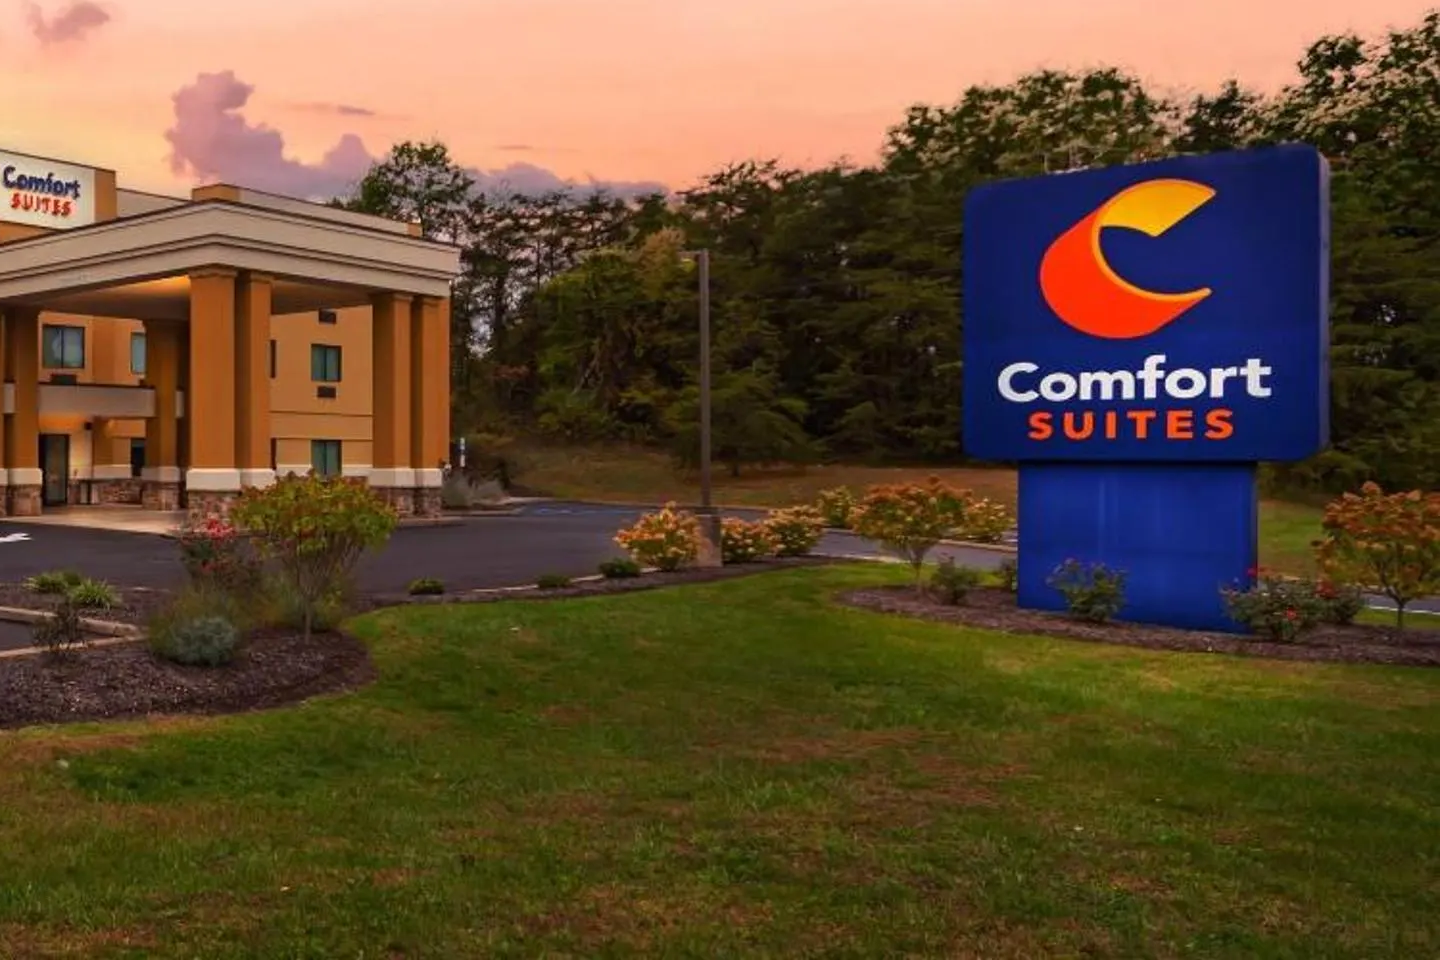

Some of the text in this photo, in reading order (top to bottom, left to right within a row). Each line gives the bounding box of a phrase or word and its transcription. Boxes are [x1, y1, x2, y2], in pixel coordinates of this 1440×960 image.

[3, 166, 80, 199] Comfort
[11, 192, 72, 217] SUITES
[997, 355, 1272, 403] Comfort
[1028, 409, 1234, 440] SUITES
